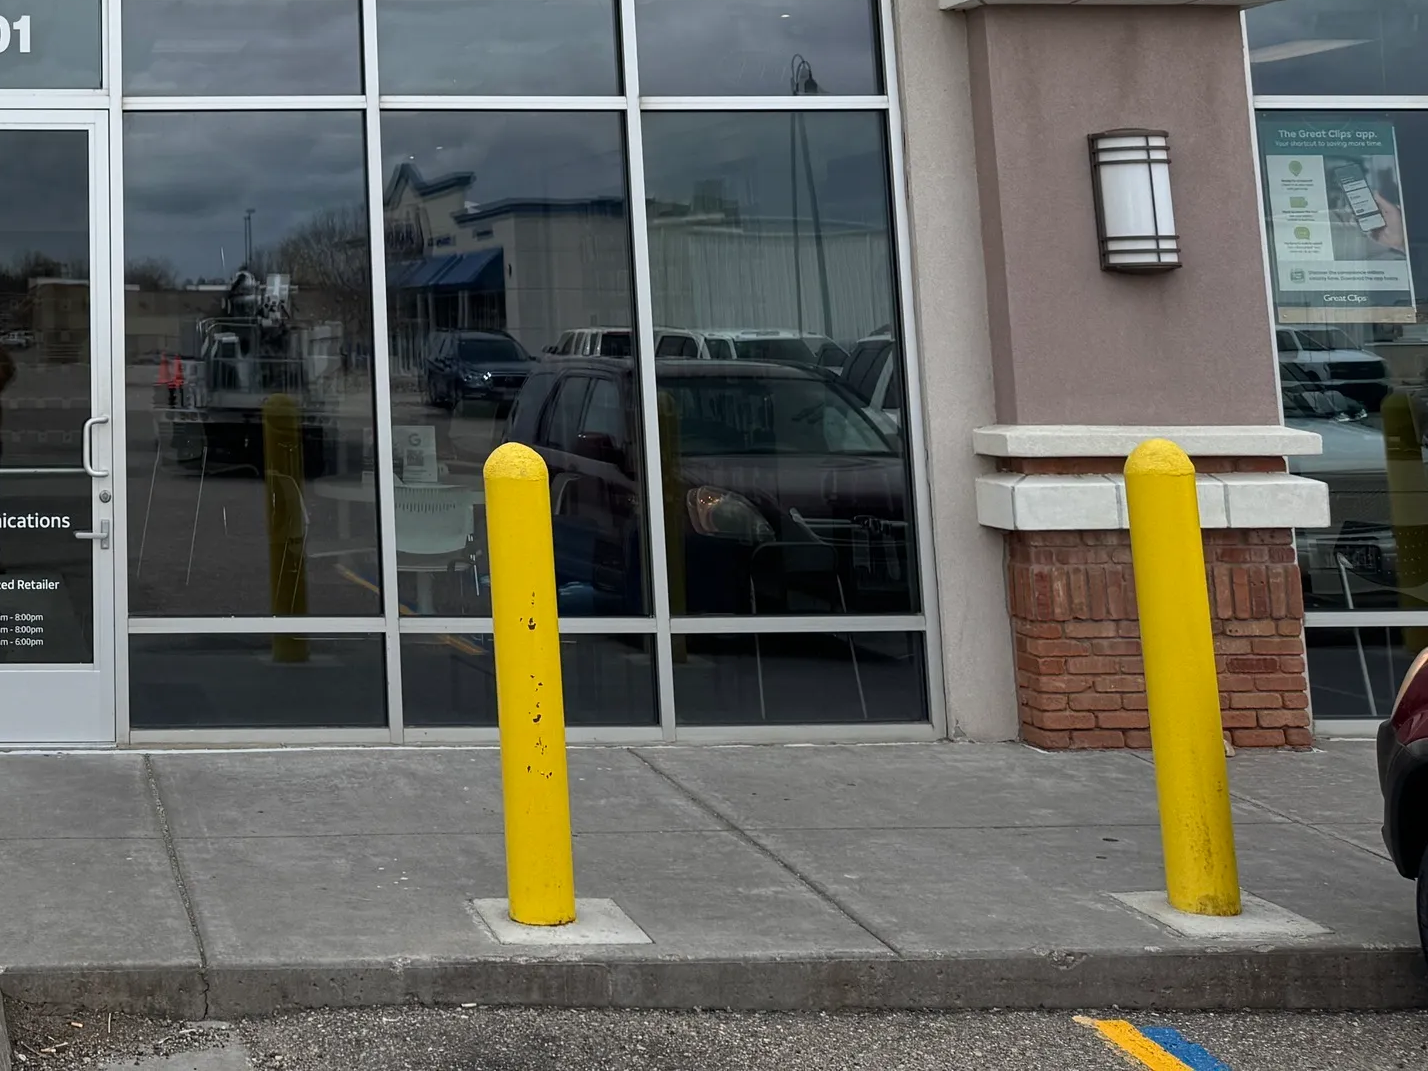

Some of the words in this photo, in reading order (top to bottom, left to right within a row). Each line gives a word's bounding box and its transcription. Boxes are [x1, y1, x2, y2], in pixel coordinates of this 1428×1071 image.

[1278, 129, 1297, 138] The
[1298, 129, 1327, 138] Great
[1323, 294, 1347, 302] Great
[17, 579, 60, 590] Retailer
[14, 613, 44, 623] 8:00pm
[14, 626, 44, 635] 8:00pm
[14, 638, 44, 647] 6:00pm
